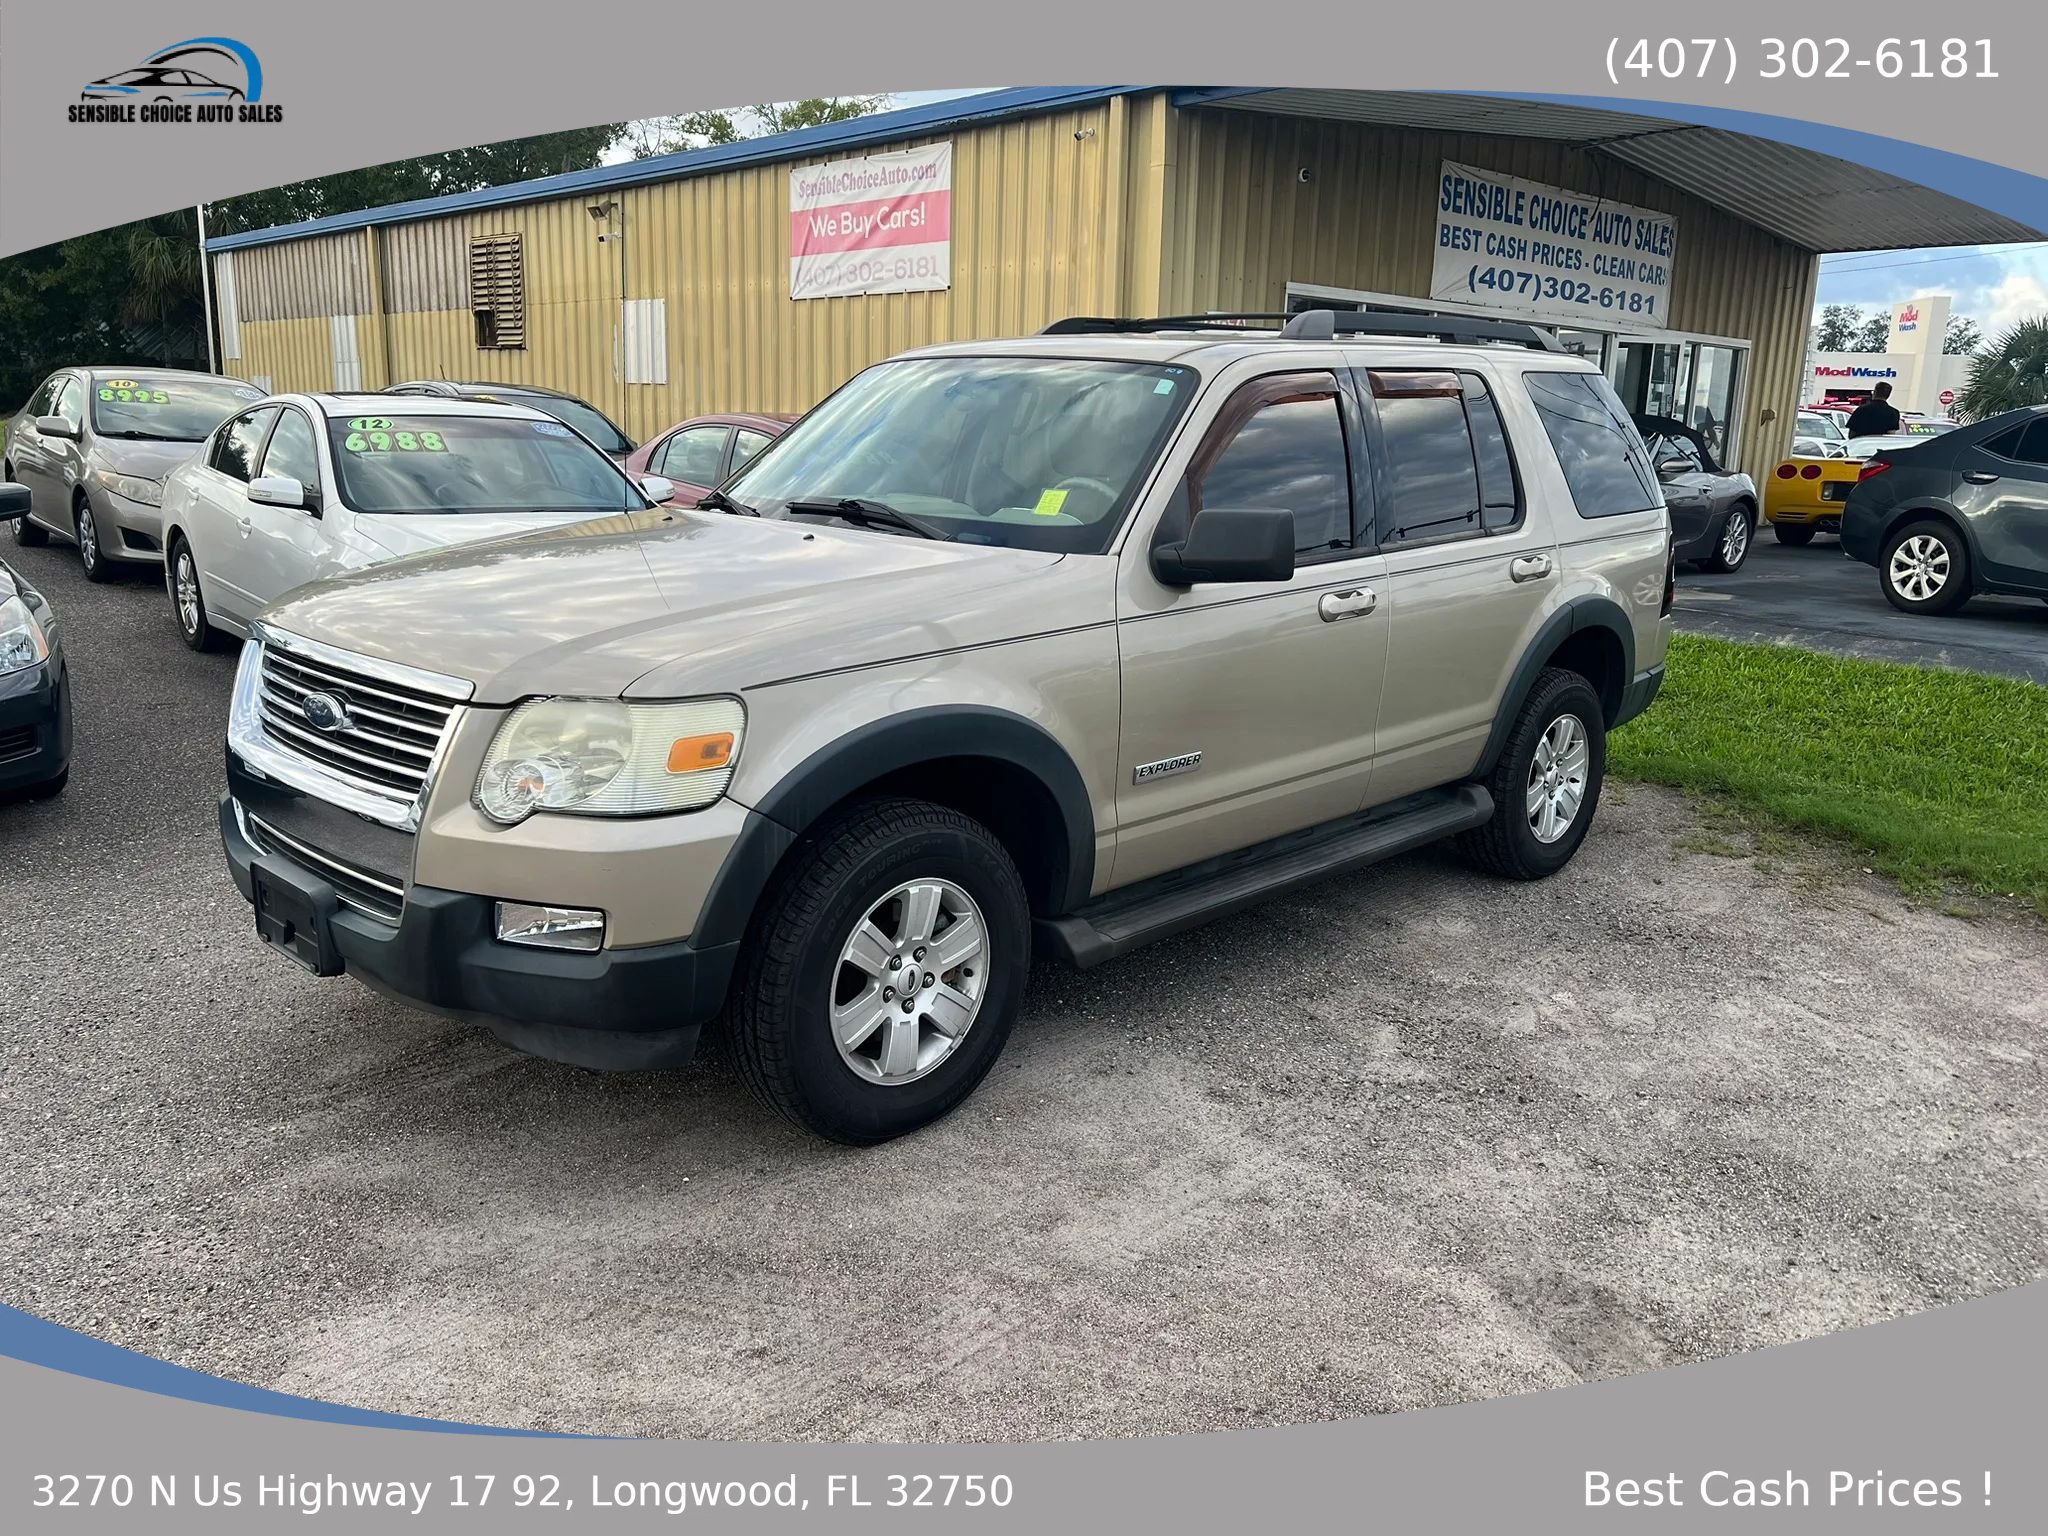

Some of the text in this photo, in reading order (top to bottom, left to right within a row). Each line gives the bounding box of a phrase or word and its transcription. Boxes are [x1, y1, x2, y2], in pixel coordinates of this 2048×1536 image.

[799, 161, 938, 199] SensibleChoiceAuto.com
[809, 201, 926, 239] We Buy Cars!
[1440, 174, 1675, 258] SENSIBLE CHOICE AUTO SALES
[1439, 223, 1483, 253] BEST
[1485, 232, 1528, 262] CASH
[1530, 241, 1583, 271] PRICES
[1592, 253, 1636, 279] CLEAN
[1467, 264, 1656, 316] (407)302-6181
[1899, 310, 1919, 323] Mod
[1815, 366, 1897, 378] ModWash
[99, 388, 170, 405] 8995
[359, 419, 384, 430] 12
[345, 431, 446, 452] 6988
[1138, 754, 1202, 778] EXPLORER
